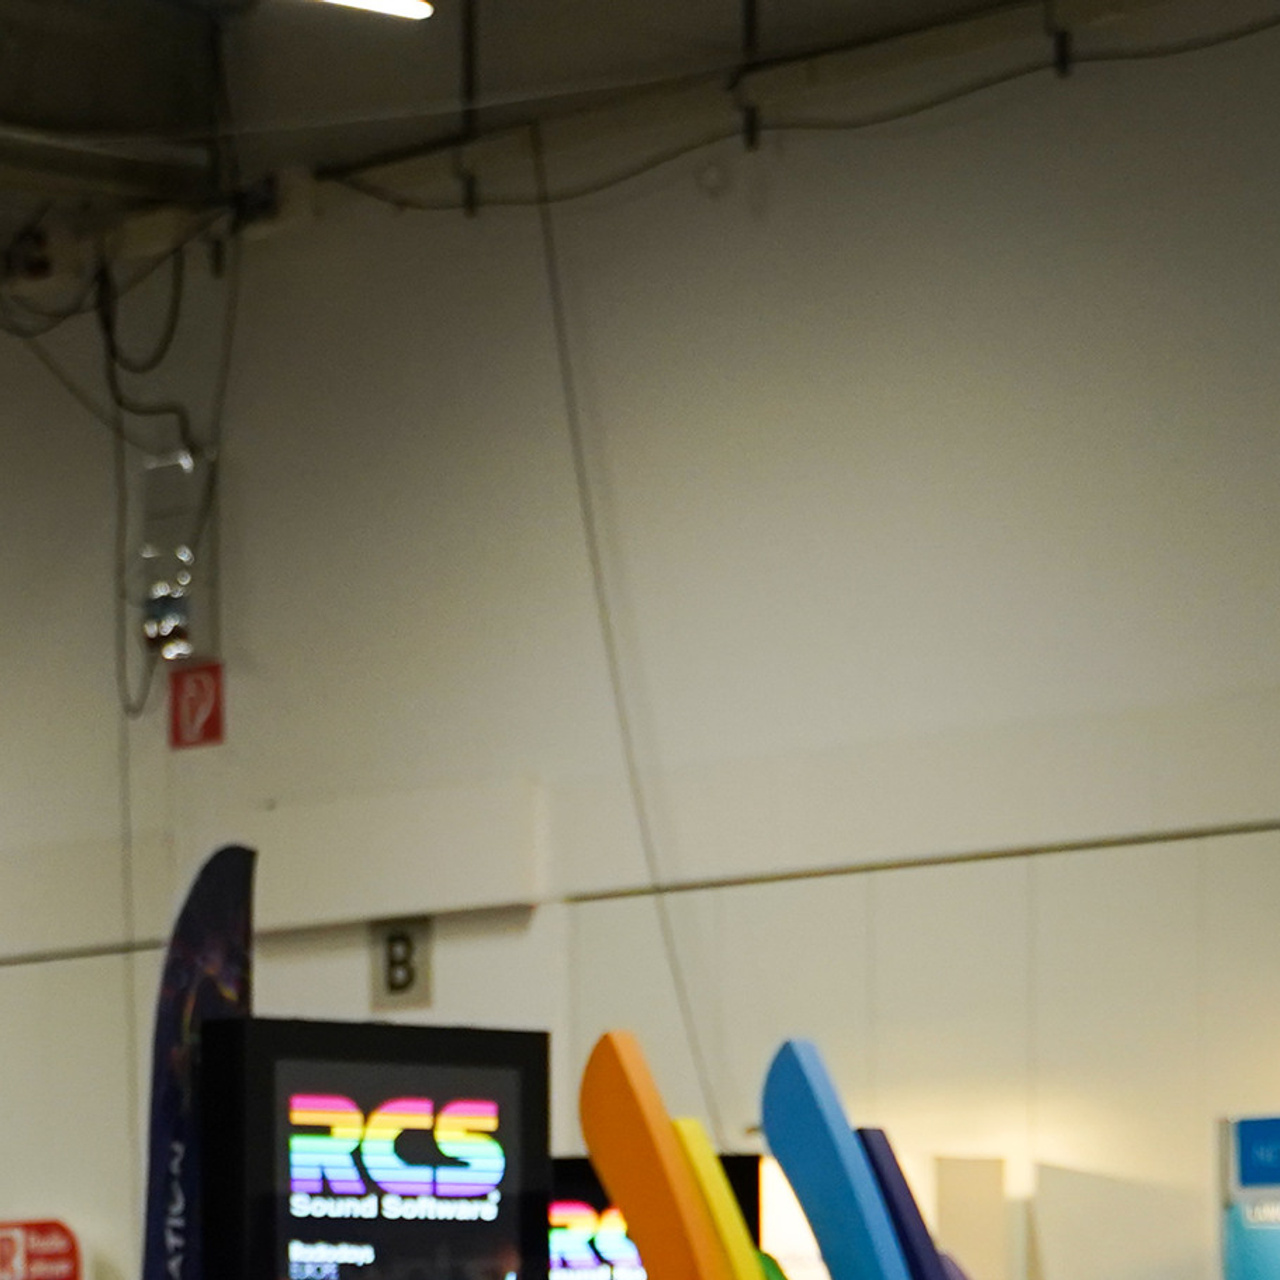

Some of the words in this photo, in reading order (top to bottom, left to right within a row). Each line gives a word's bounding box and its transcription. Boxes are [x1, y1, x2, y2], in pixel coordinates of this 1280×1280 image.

[385, 933, 416, 994] B
[289, 1093, 506, 1197] RCS
[289, 1192, 378, 1219] Sound
